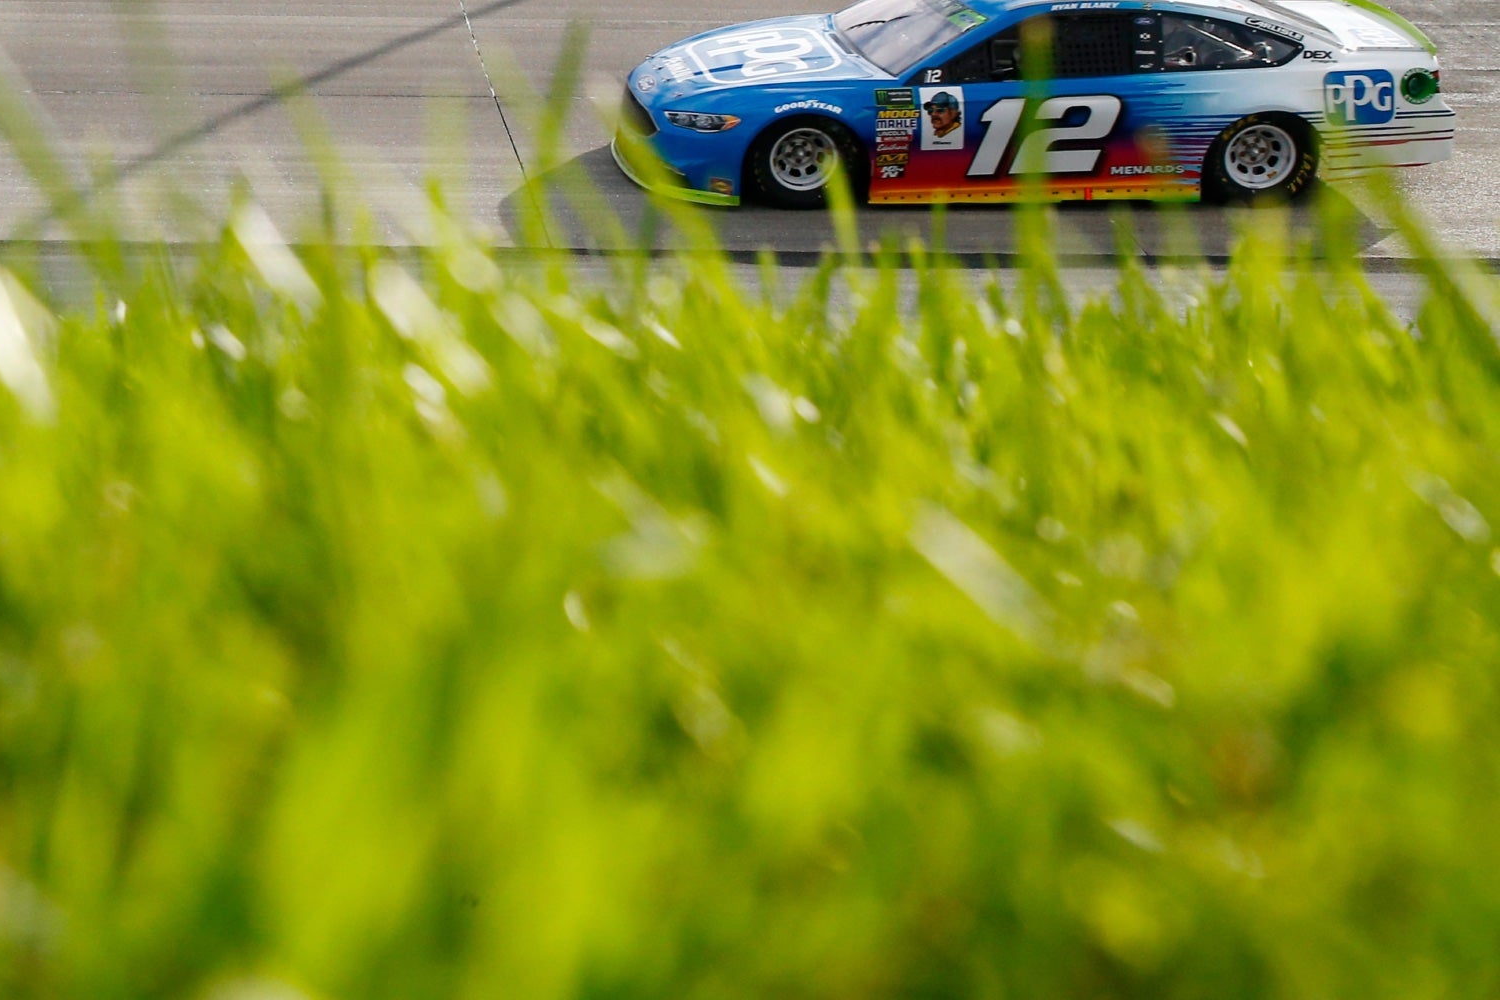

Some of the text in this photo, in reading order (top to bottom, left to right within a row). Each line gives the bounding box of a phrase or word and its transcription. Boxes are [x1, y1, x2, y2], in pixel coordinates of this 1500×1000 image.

[1051, 1, 1120, 11] RYAN BLANEY
[1247, 18, 1302, 40] CARLISLE
[1303, 50, 1332, 59] DEX
[924, 69, 942, 83] 12
[1326, 75, 1393, 121] PPG
[774, 99, 843, 115] GOODYEAR
[878, 109, 921, 119] MOOG
[877, 119, 917, 128] MAHLE
[967, 94, 1122, 176] 12
[1110, 164, 1187, 175] MENARDS
